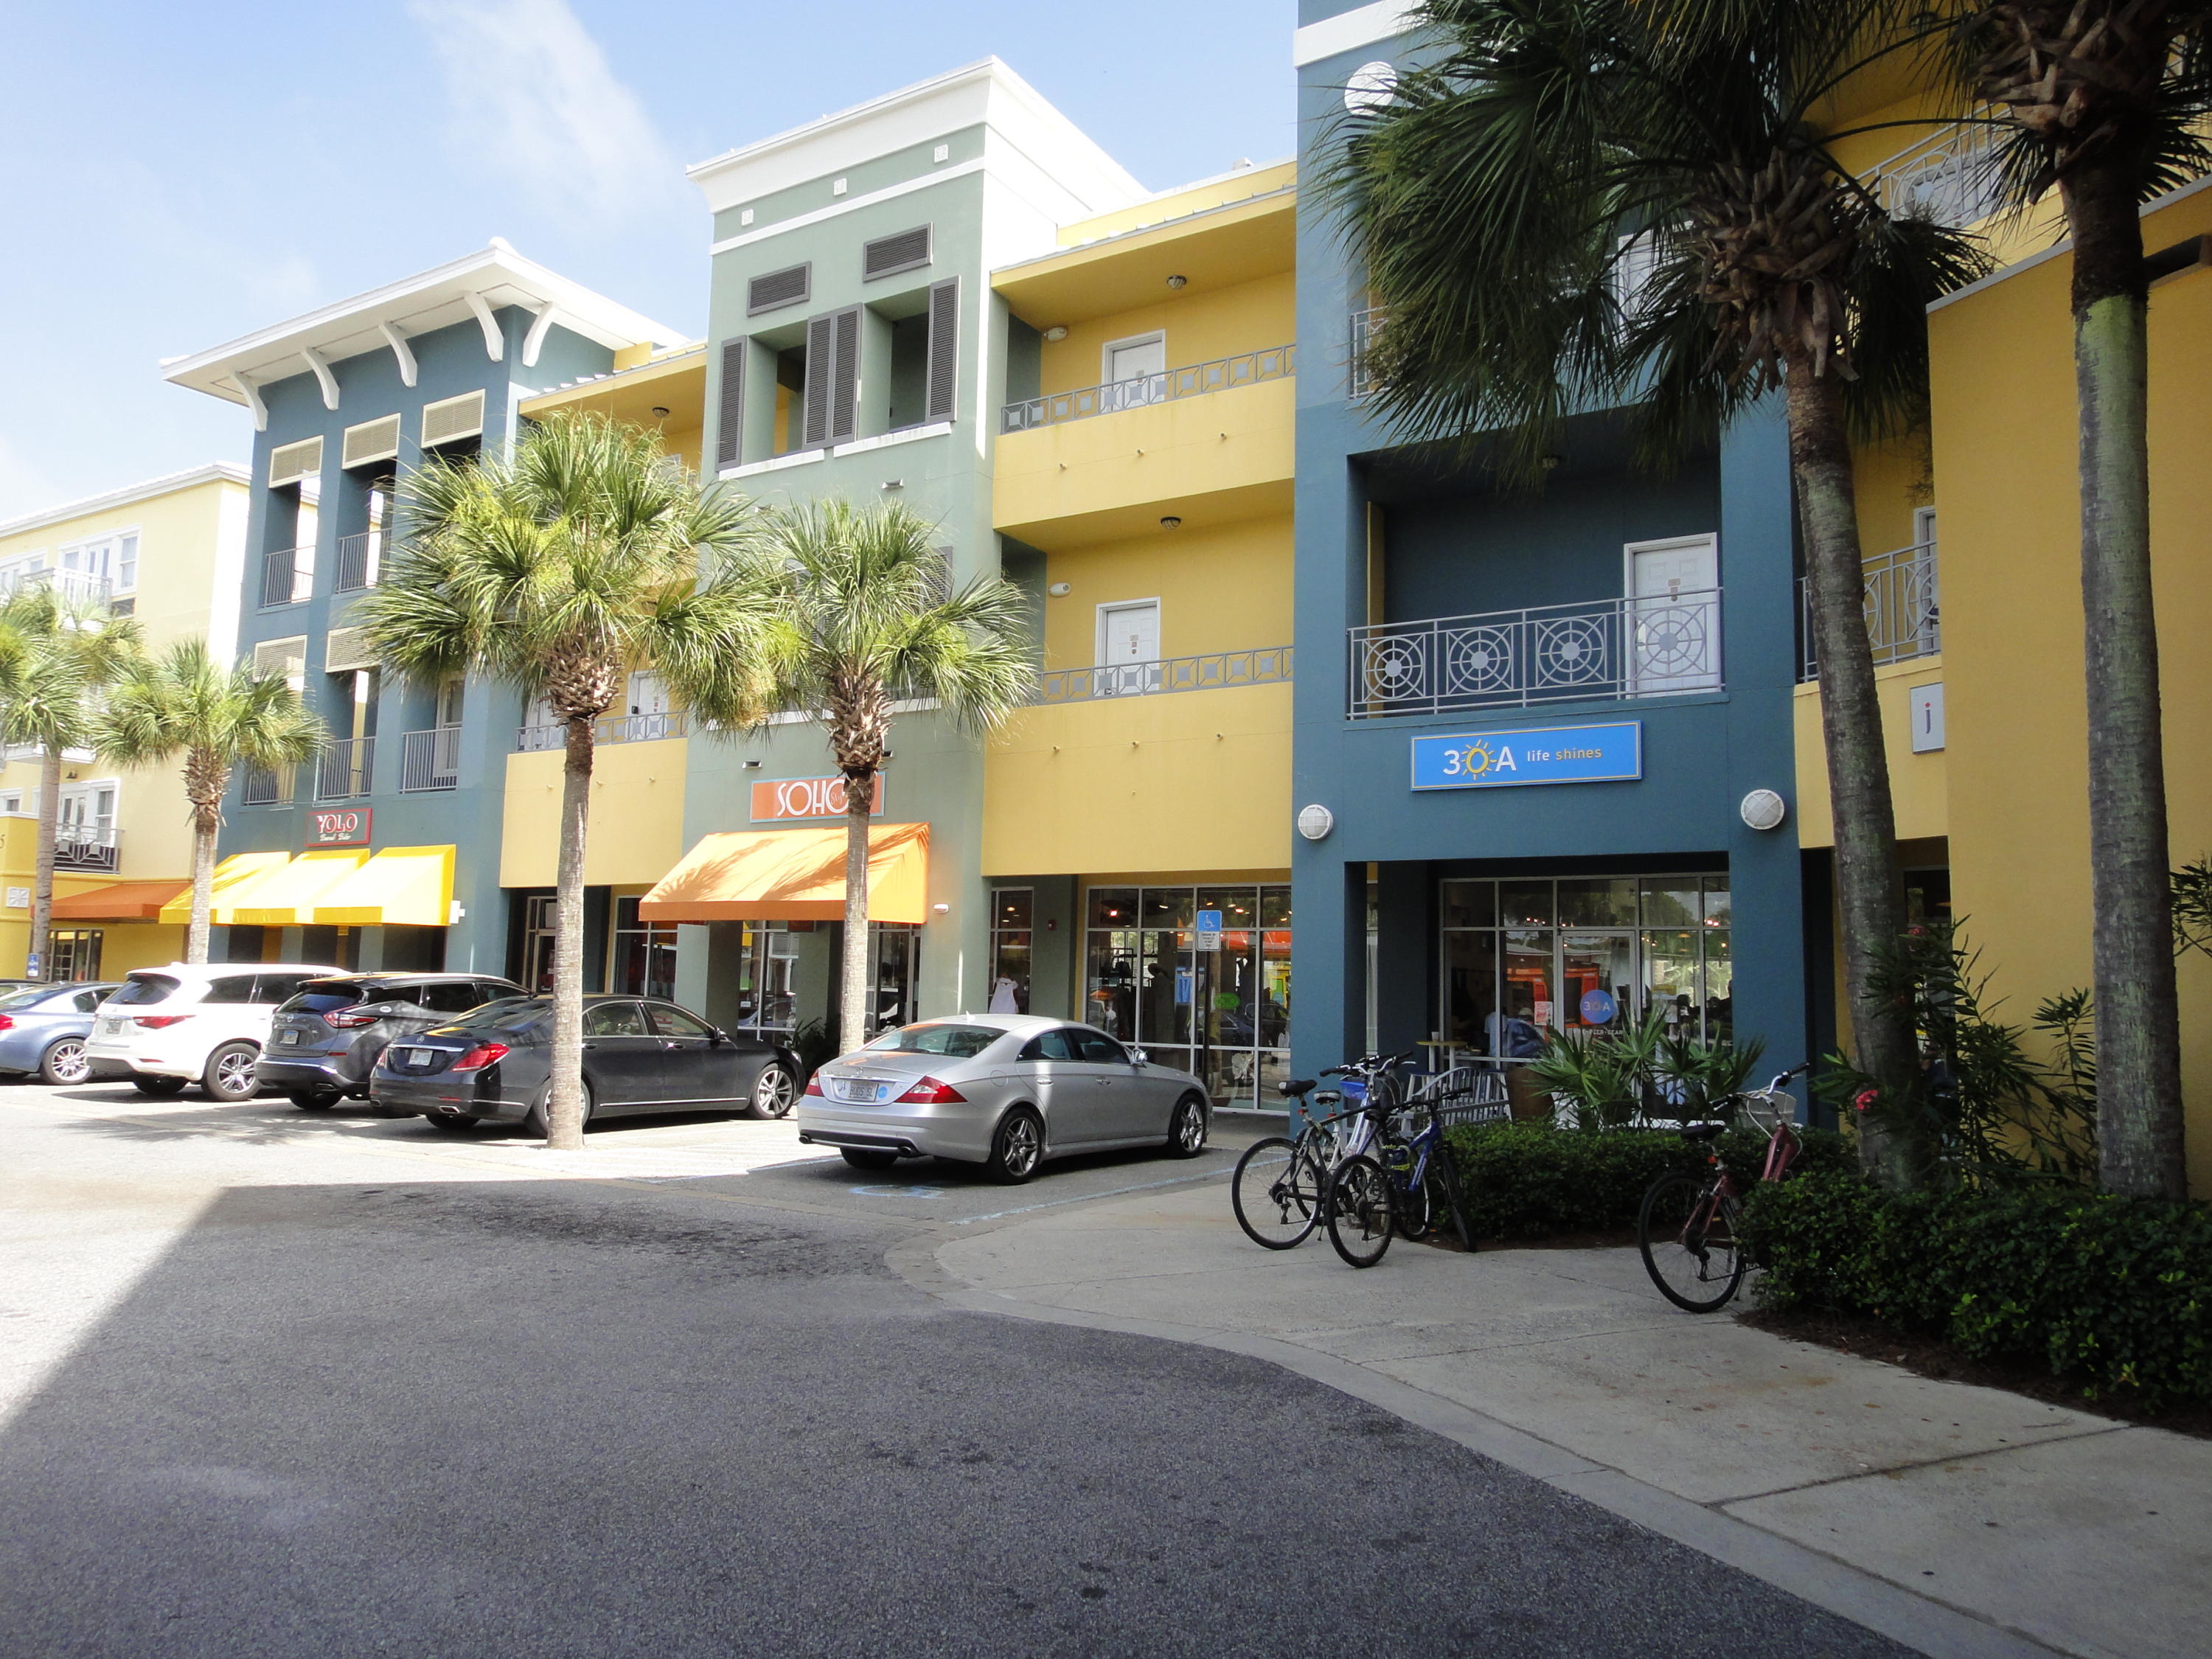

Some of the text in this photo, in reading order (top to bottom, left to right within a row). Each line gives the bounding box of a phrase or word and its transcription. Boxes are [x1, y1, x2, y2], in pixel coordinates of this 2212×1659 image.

[1443, 745, 1602, 776] 30A life shines
[776, 779, 850, 817] SOHO
[316, 813, 358, 834] YOLO
[1583, 1001, 1611, 1012] 30A
